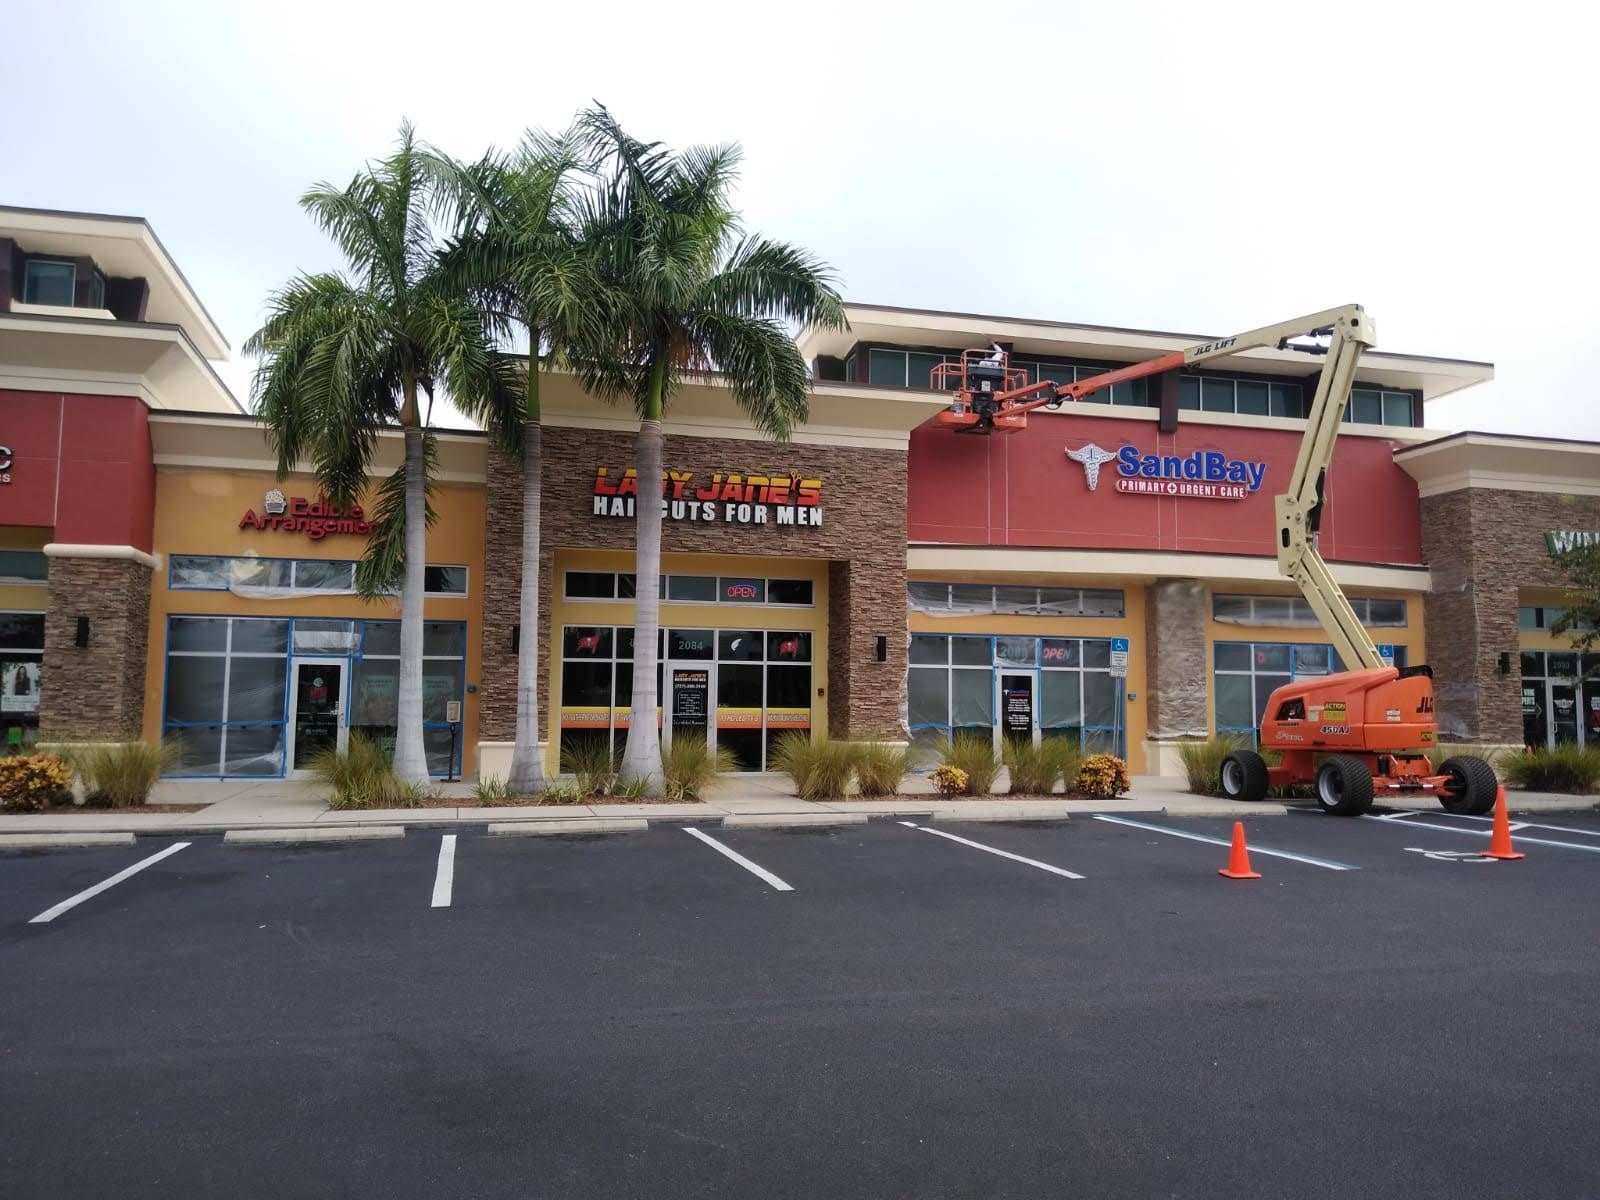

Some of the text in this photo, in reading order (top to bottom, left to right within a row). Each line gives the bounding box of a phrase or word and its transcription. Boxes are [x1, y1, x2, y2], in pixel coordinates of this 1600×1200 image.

[1194, 337, 1236, 356] JLG LIFT
[1117, 444, 1267, 492] SandBay
[594, 467, 692, 500] LAY
[1121, 480, 1245, 498] PRIMARY URGENT CARE
[593, 496, 823, 526] HAICUTS FOR MEN
[727, 586, 757, 598] OPEN
[678, 640, 703, 650] 2084
[1321, 725, 1350, 735] 450AJ
